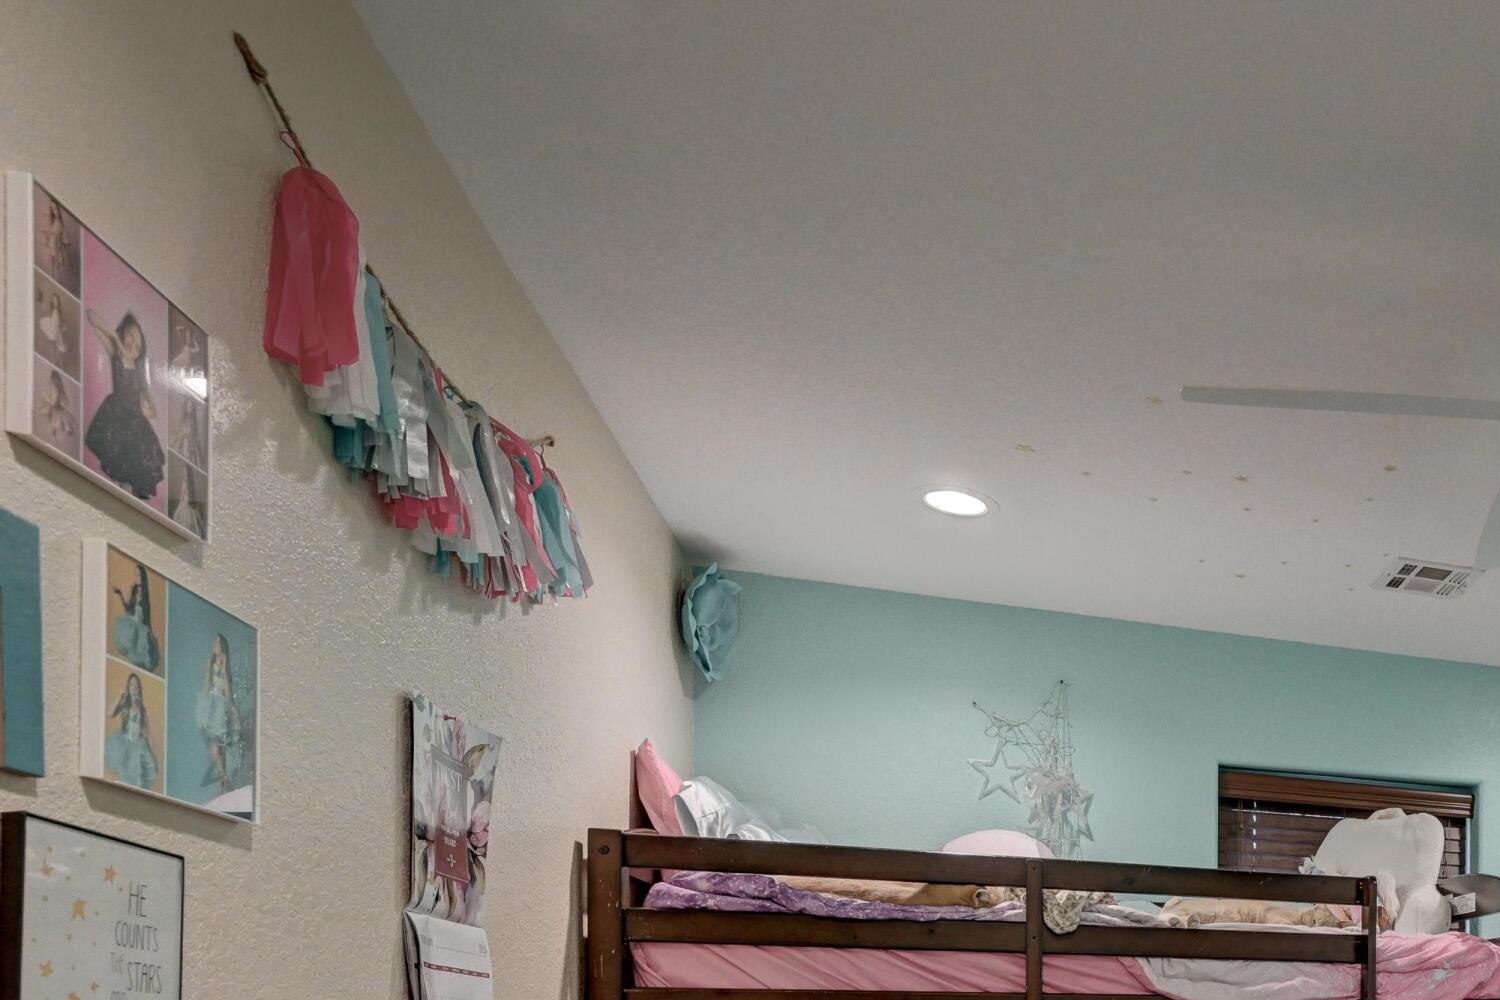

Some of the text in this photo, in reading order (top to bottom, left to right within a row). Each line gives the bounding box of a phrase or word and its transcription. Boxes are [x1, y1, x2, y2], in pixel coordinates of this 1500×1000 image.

[127, 881, 148, 918] HE
[114, 920, 159, 952] COUNTS
[127, 961, 162, 994] STARS
